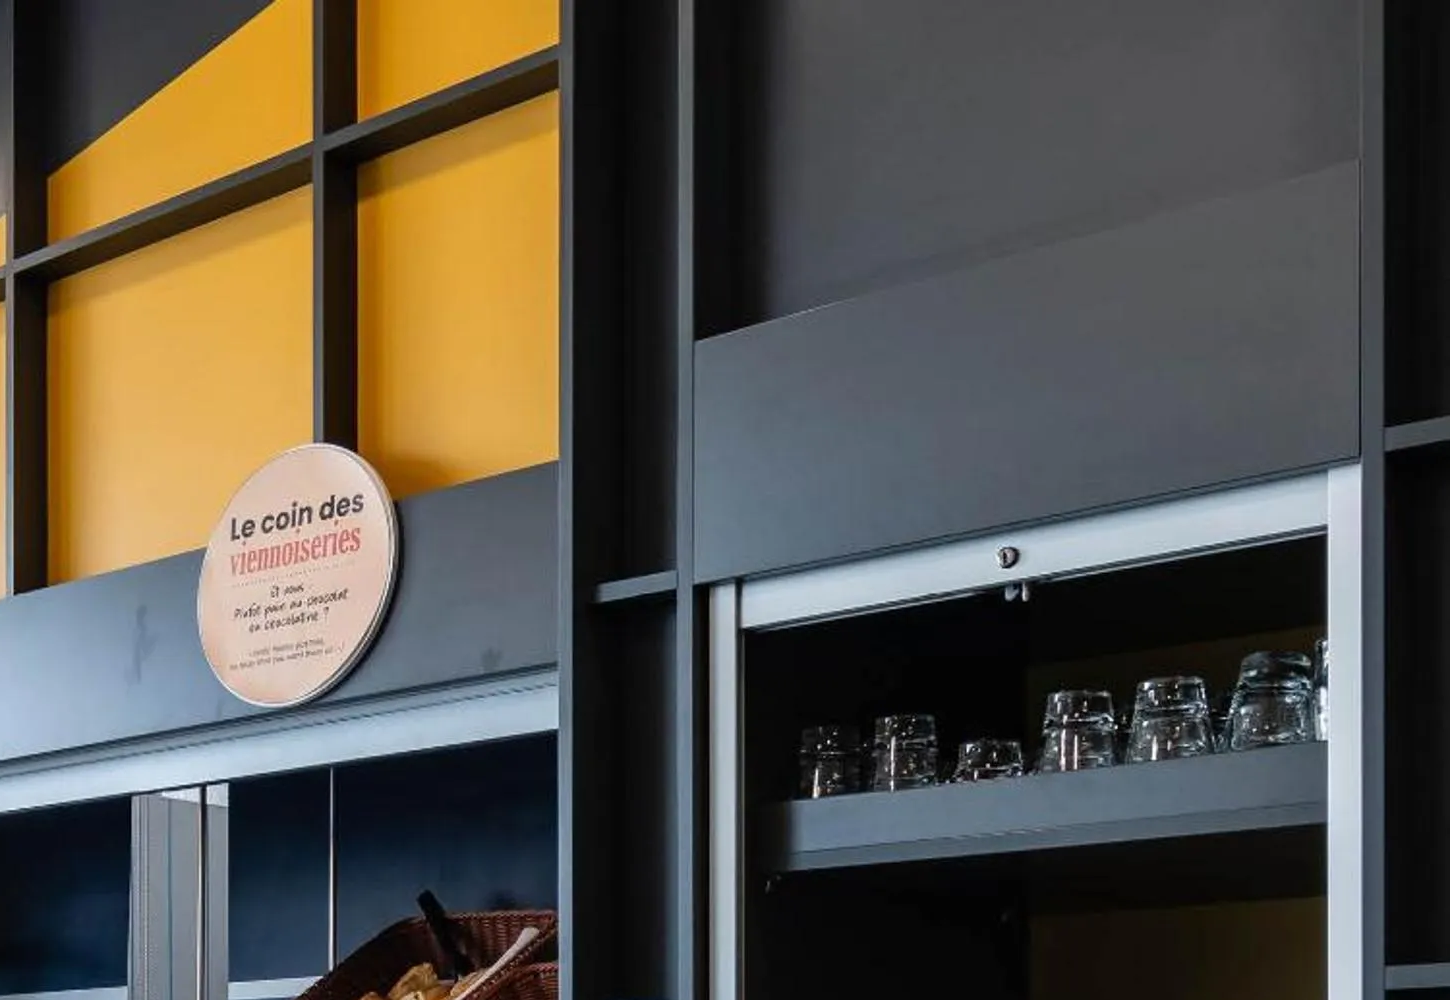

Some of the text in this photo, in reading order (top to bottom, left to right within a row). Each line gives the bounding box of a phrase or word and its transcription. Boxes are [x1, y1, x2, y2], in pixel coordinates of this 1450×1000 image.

[230, 494, 364, 541] Le coin des
[231, 520, 362, 576] viennoiseries
